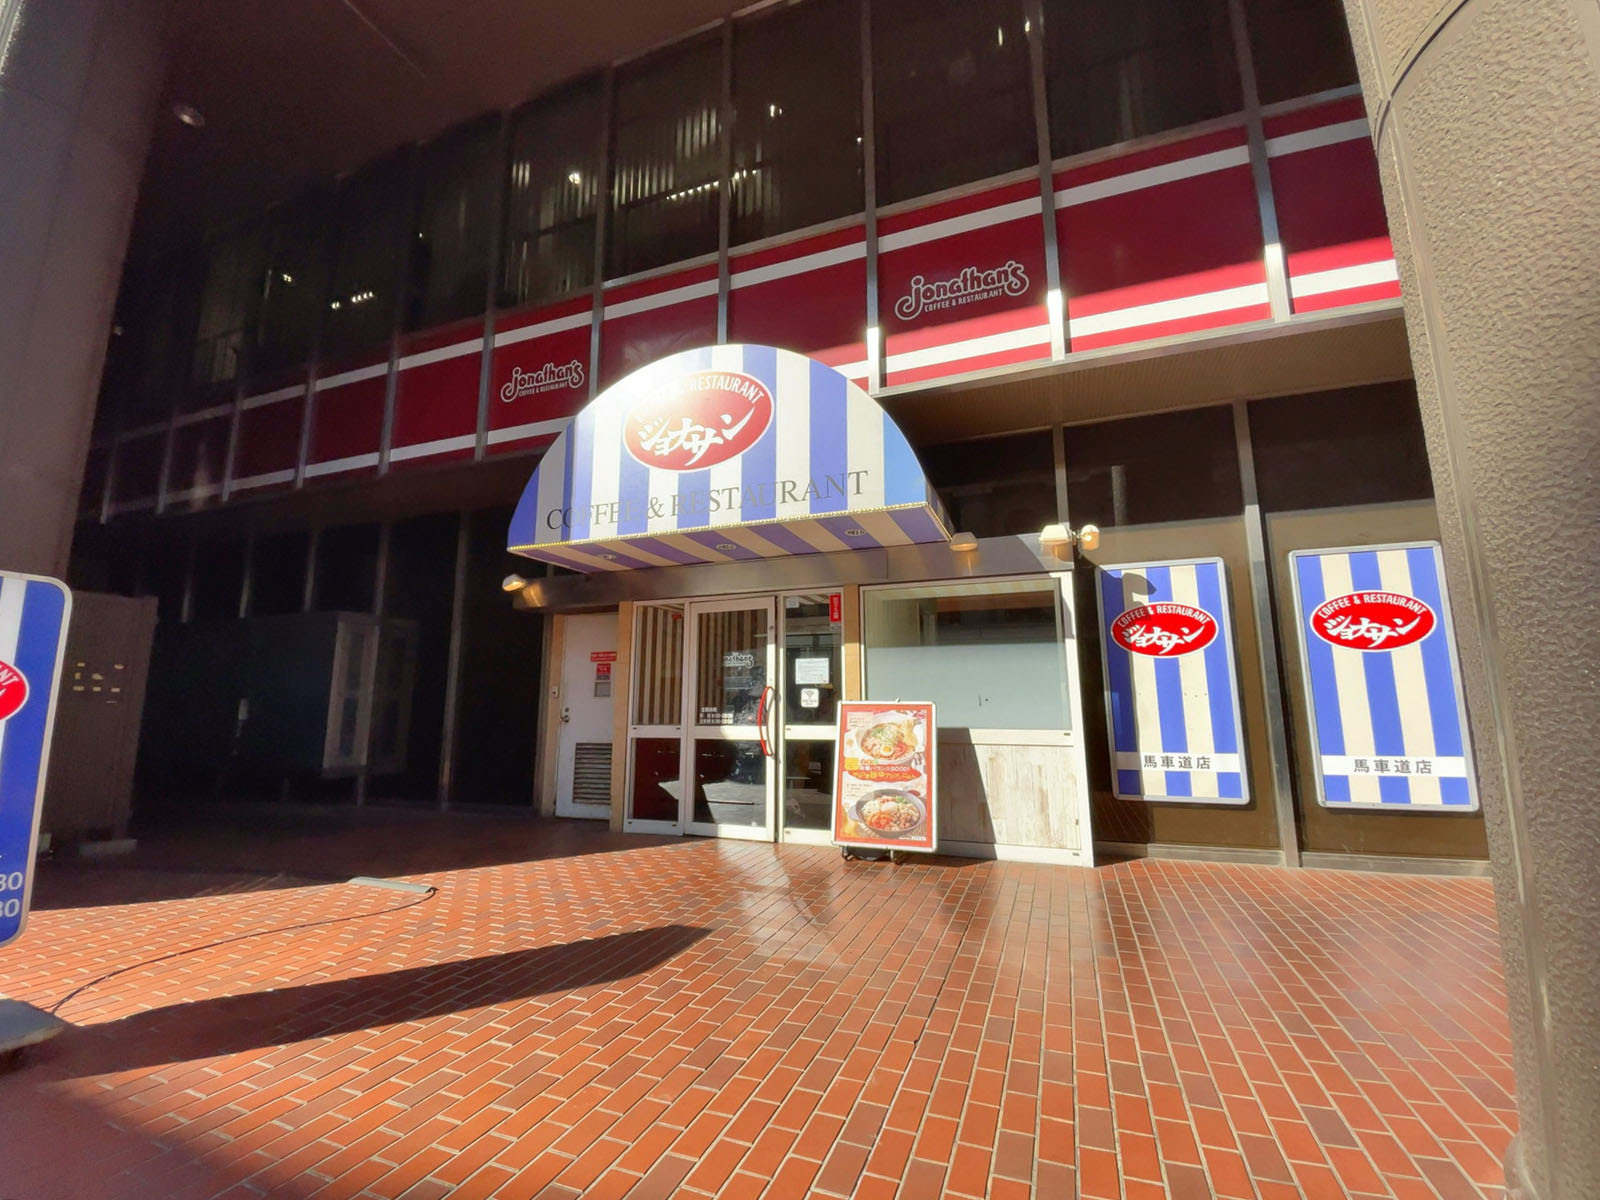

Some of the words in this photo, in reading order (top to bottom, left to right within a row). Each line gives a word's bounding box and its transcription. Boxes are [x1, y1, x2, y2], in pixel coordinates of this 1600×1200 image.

[924, 301, 950, 312] COFFEE
[958, 288, 1003, 305] RESTAURANT
[635, 406, 756, 466] ジョナサン
[647, 496, 666, 519] &
[671, 470, 869, 517] RESTAURANT
[1117, 607, 1146, 627] COFFEE
[1147, 606, 1155, 615] &
[1156, 605, 1211, 624] RESTAURANT
[1317, 597, 1351, 619] COFFEE
[1352, 595, 1361, 605] &
[1363, 593, 1428, 615] RESTAURANT
[1122, 624, 1205, 655] ジョナサン
[1323, 615, 1421, 648] ジョナサン
[1143, 755, 1212, 770] 馬車道店
[1353, 758, 1433, 775] 馬車道店
